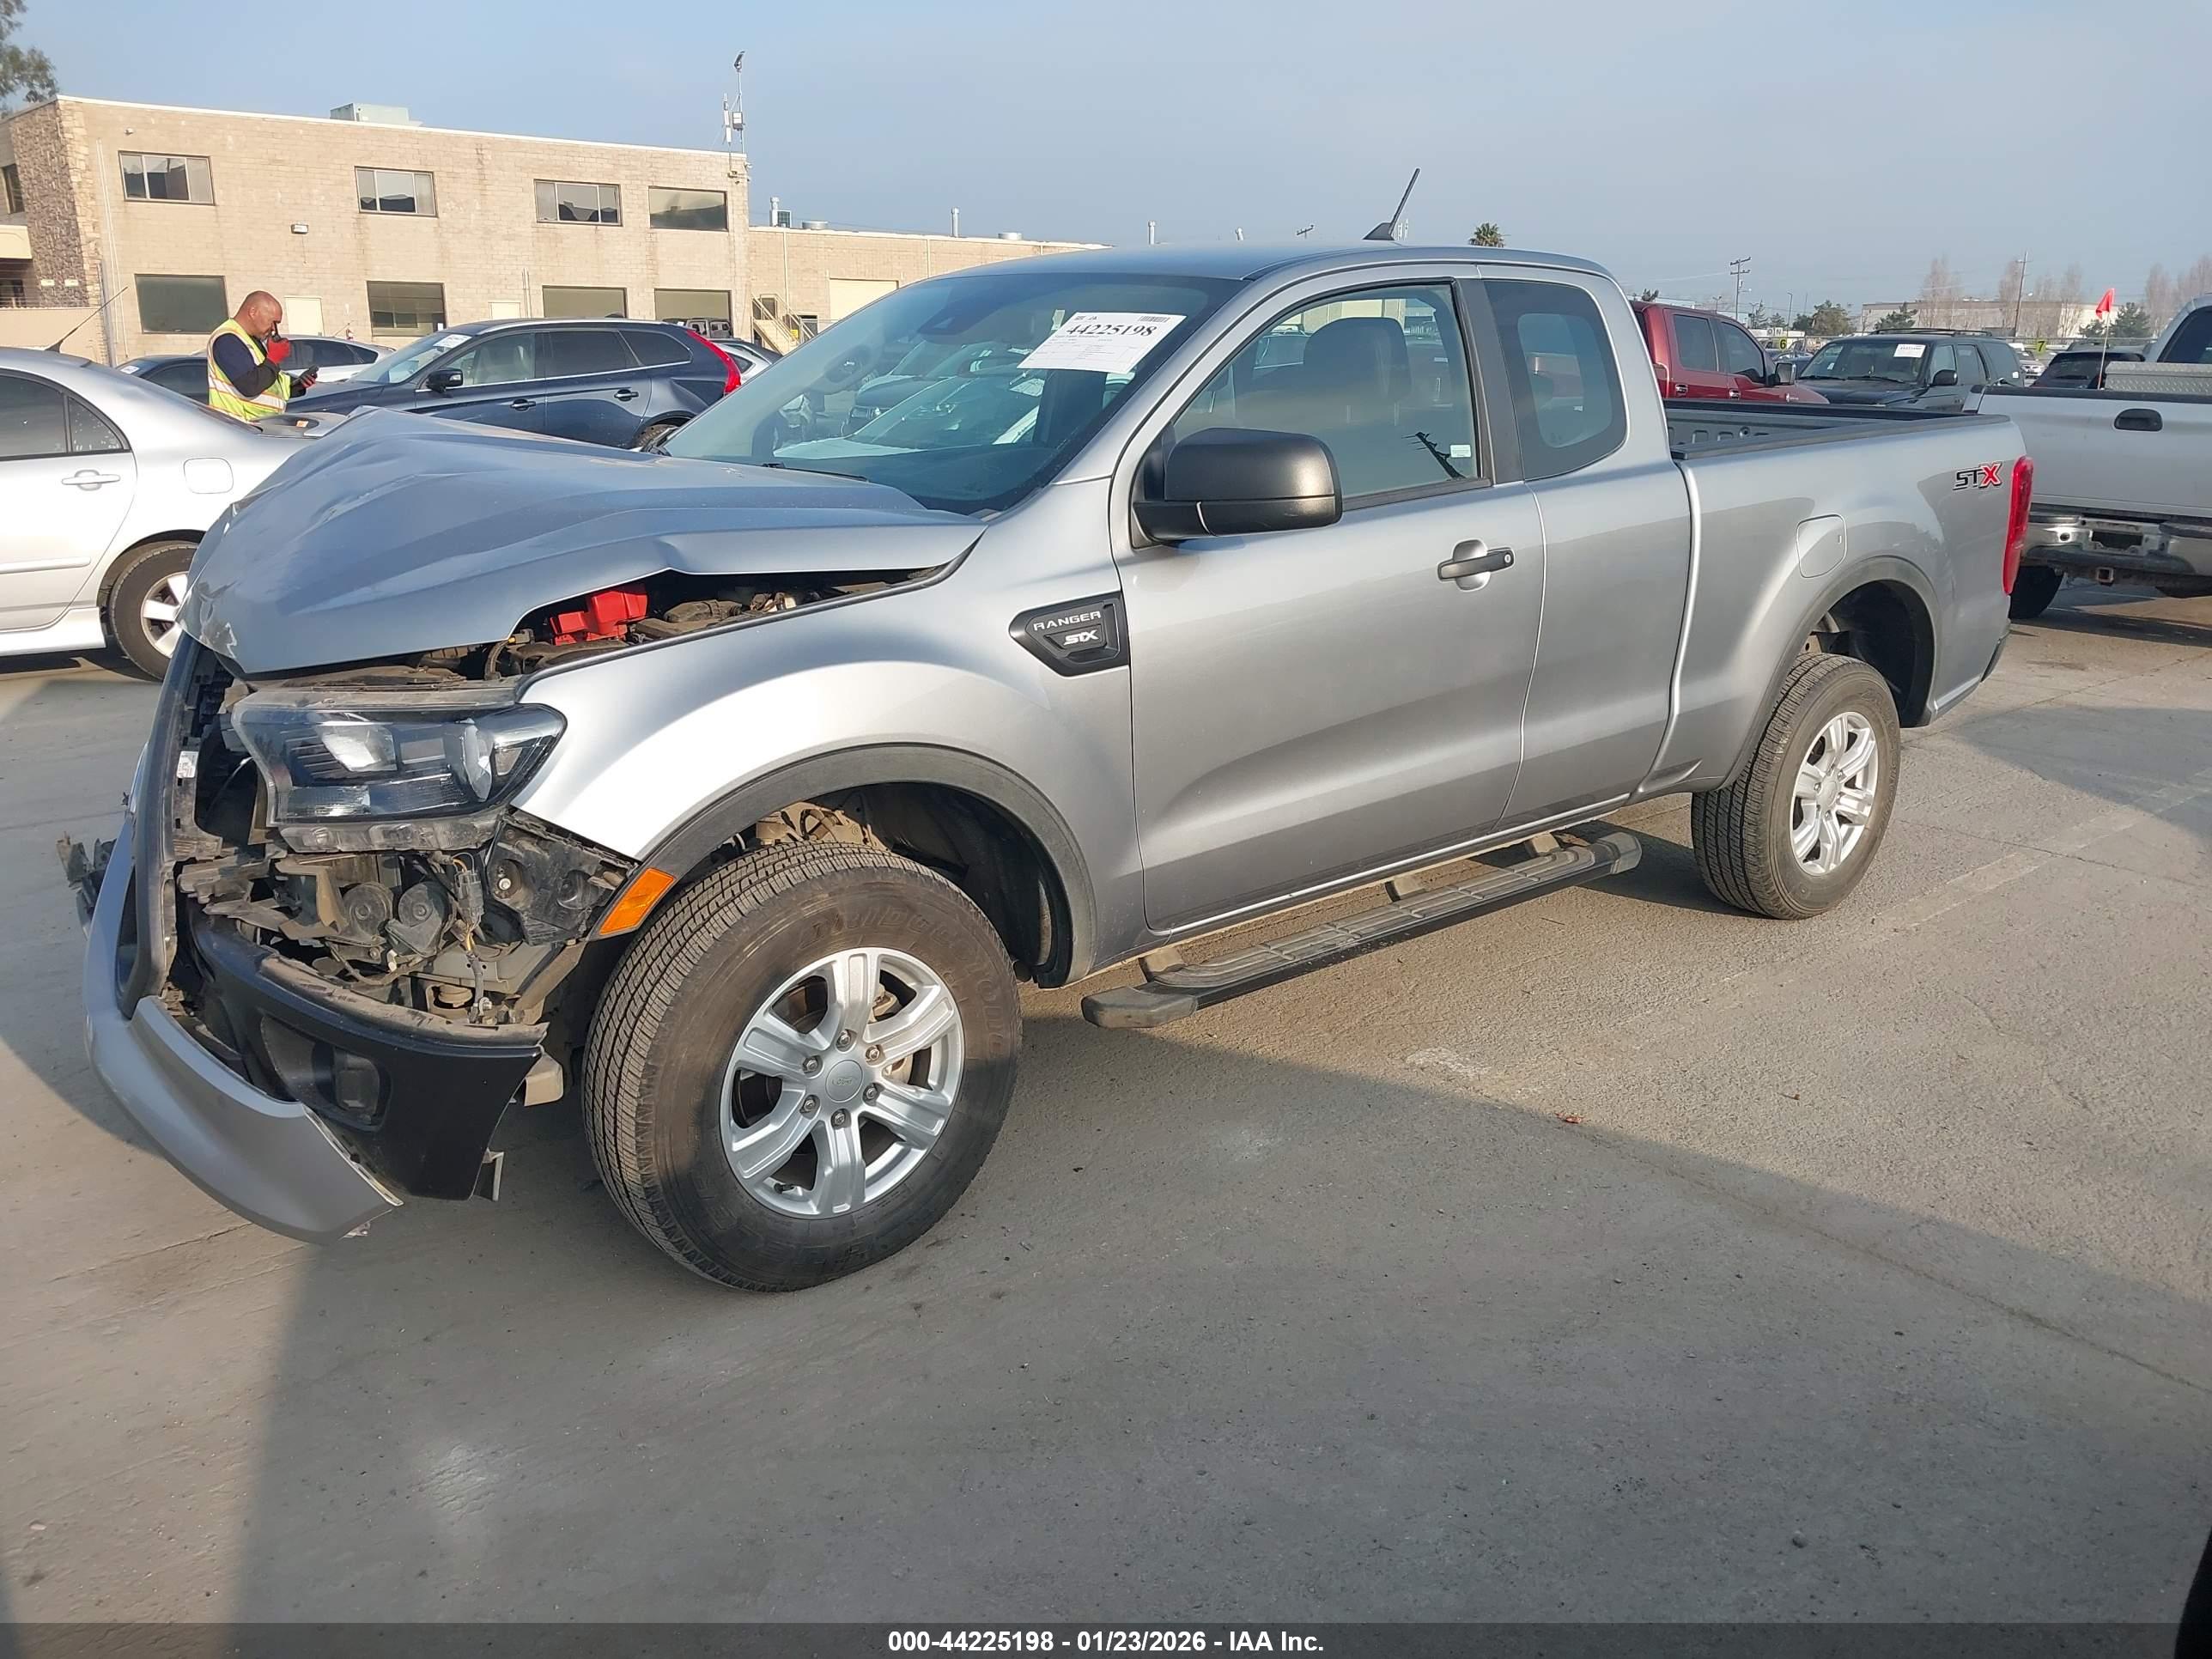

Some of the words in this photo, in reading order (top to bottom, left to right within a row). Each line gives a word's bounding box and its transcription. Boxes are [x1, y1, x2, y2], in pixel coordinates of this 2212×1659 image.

[1066, 324, 1157, 337] 44225198
[1780, 339, 1786, 349] 6
[2038, 340, 2045, 352] 7
[1953, 461, 2002, 490] STX
[1033, 611, 1102, 631] RANGER
[1063, 629, 1099, 646] STX
